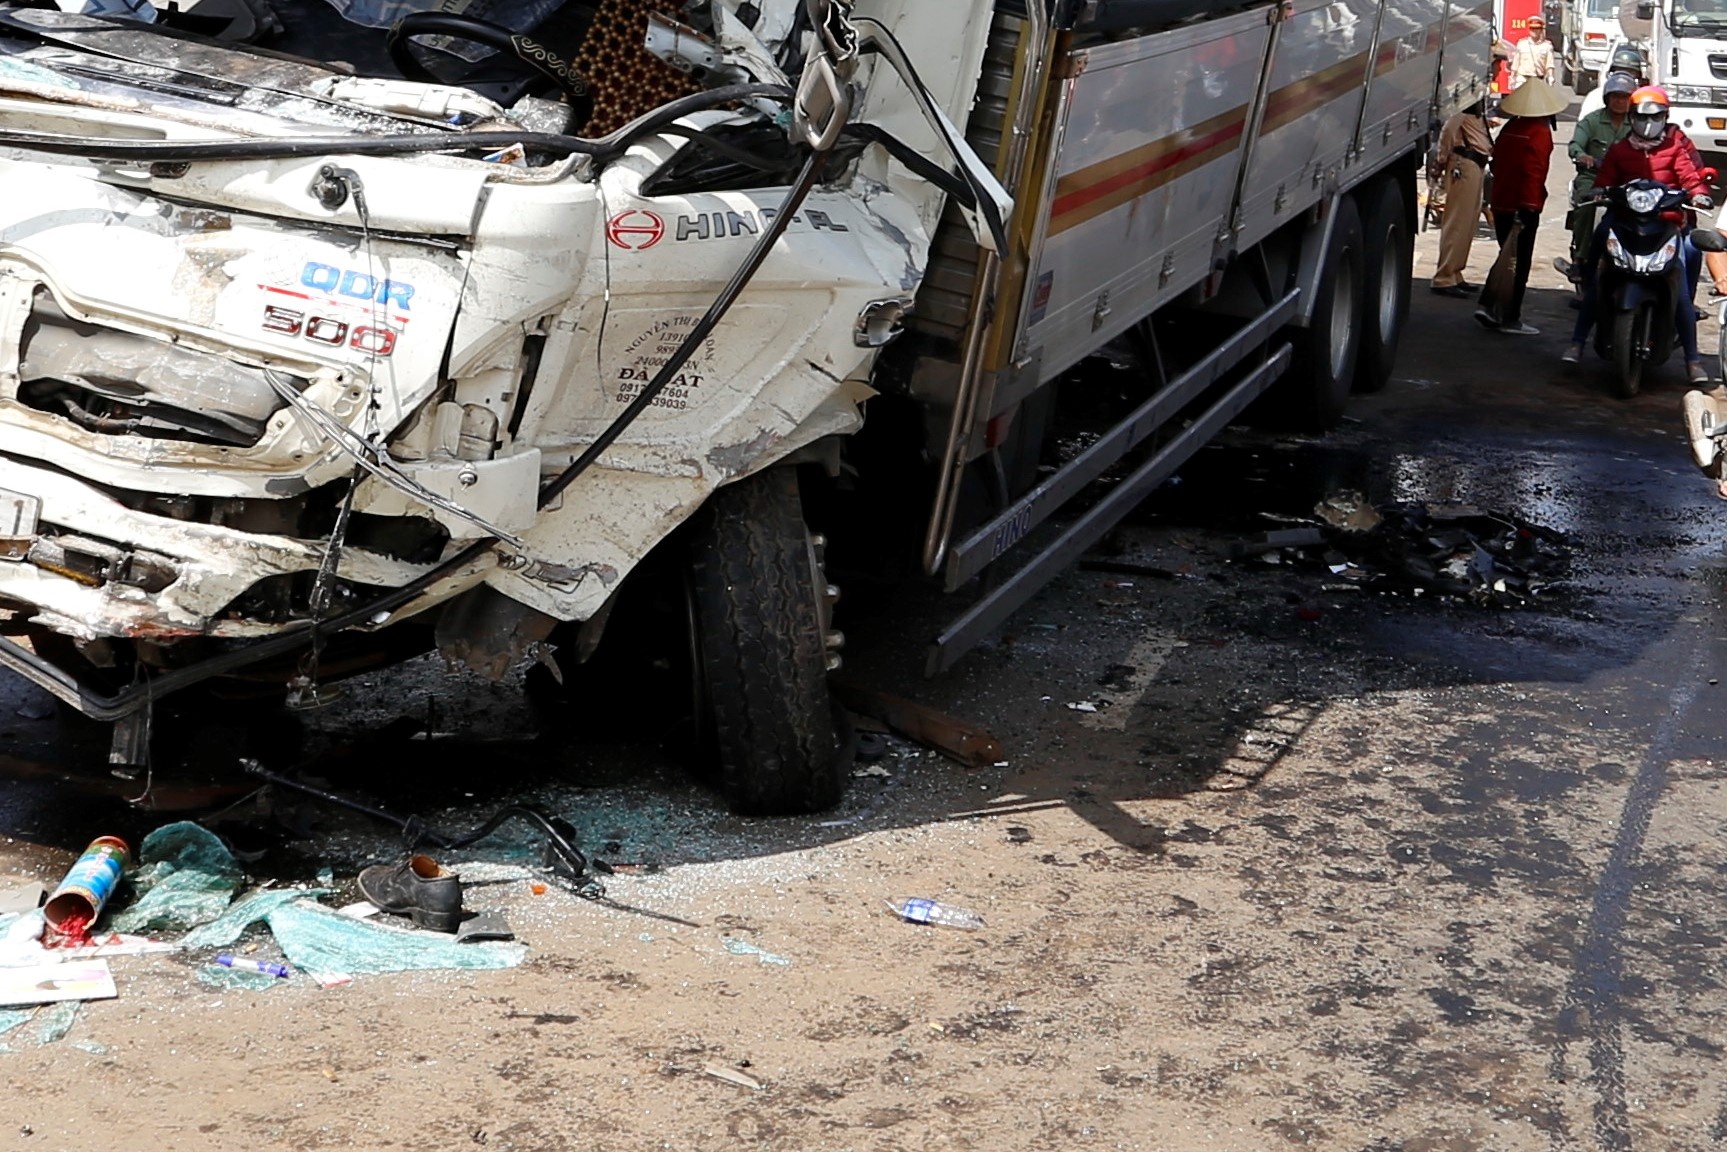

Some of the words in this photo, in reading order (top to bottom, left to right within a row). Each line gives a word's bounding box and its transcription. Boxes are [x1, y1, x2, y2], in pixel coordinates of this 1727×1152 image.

[300, 261, 416, 311] QDR
[261, 304, 398, 357] 500
[671, 373, 704, 389] ẠT
